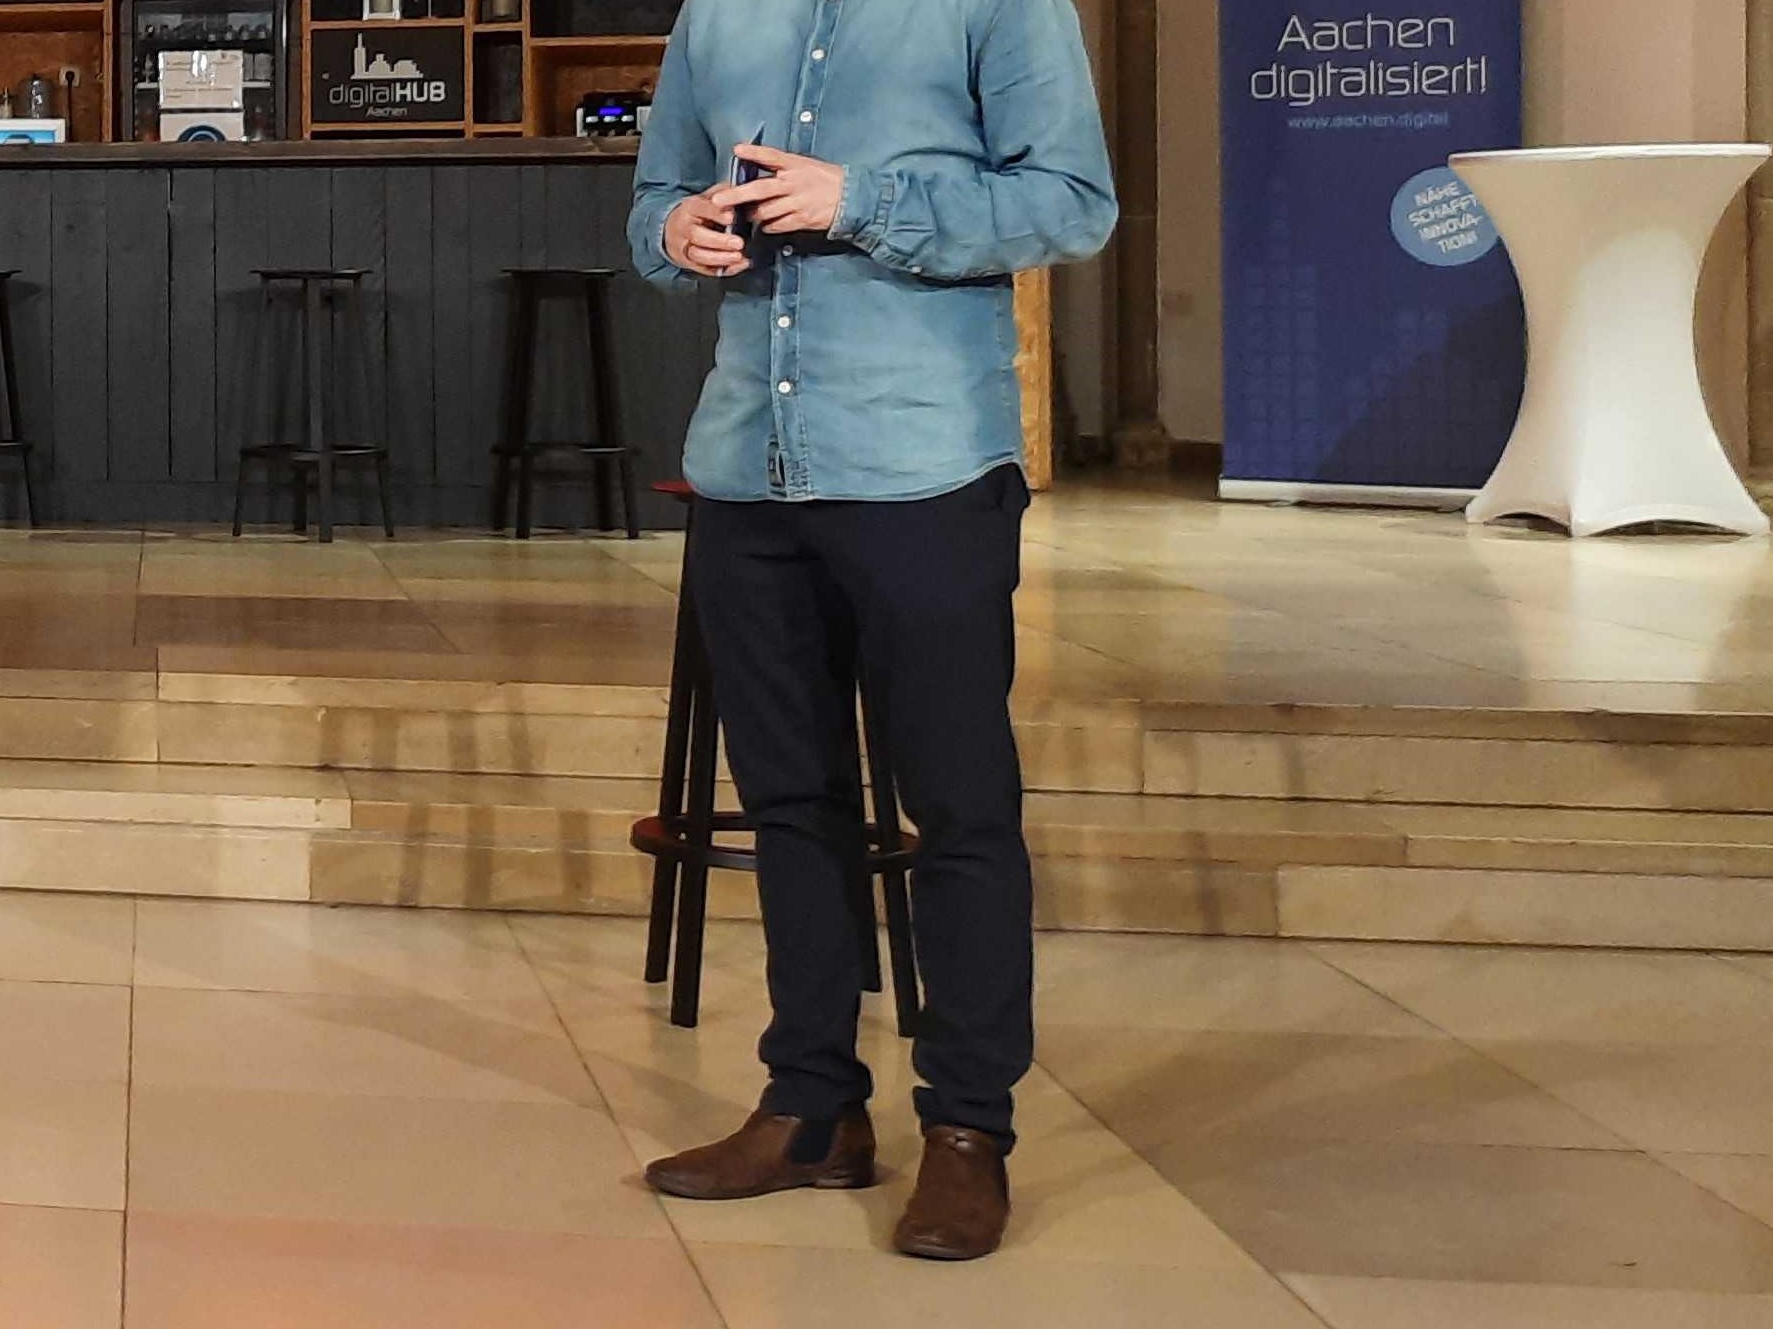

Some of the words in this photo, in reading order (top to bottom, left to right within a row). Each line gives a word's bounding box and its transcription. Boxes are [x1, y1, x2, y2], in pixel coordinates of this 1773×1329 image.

[1277, 12, 1456, 52] Aachen
[329, 81, 446, 108] digitalHUB
[1250, 55, 1487, 107] digitalisiert!
